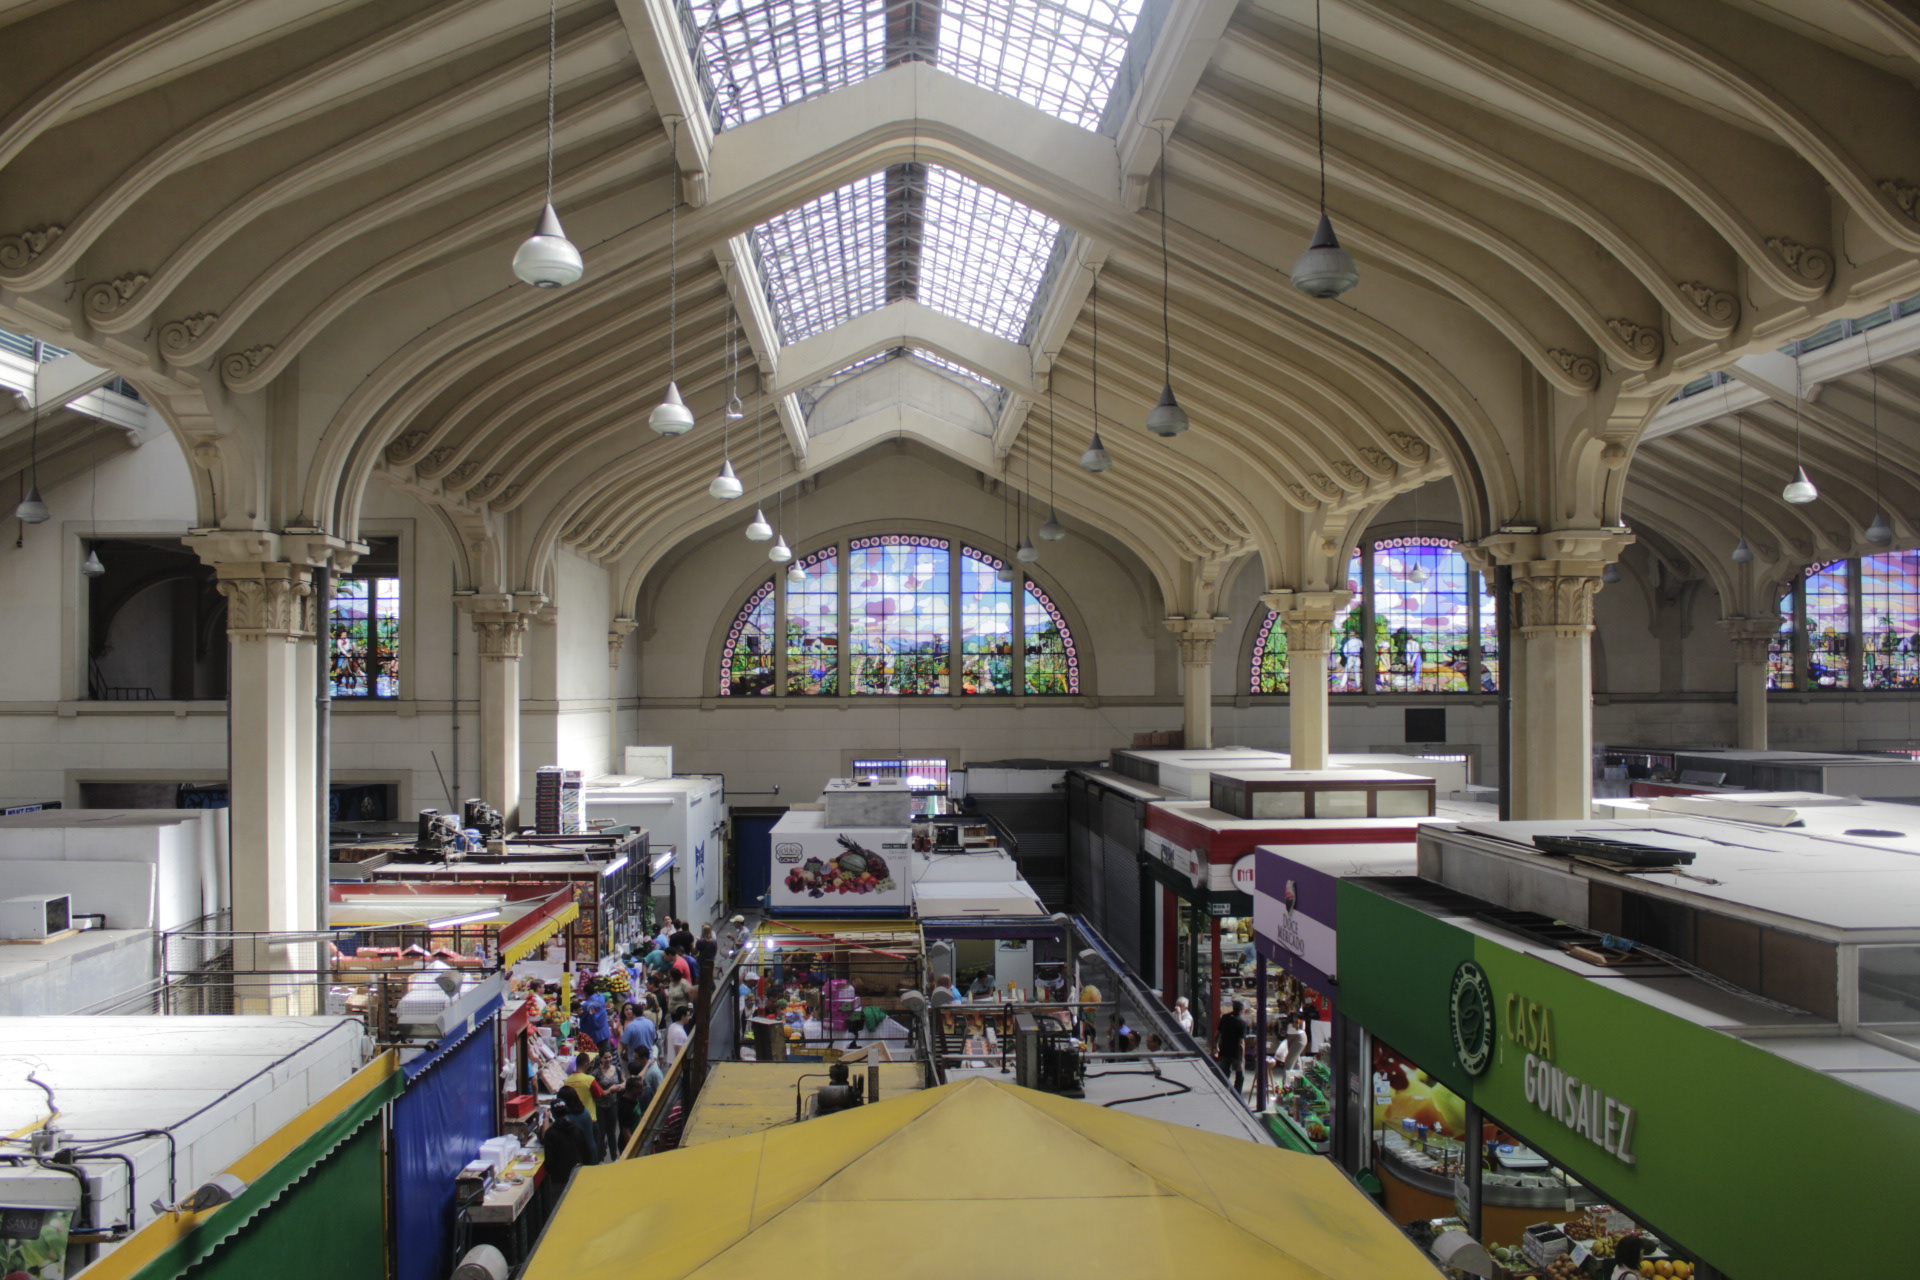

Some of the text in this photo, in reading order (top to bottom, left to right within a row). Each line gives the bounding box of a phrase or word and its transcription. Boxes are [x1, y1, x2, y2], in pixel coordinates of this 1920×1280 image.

[1277, 923, 1305, 951] MERCADO
[1283, 913, 1298, 935] DOCE
[1506, 993, 1554, 1061] CASA
[1524, 1053, 1637, 1165] GONSALEZ
